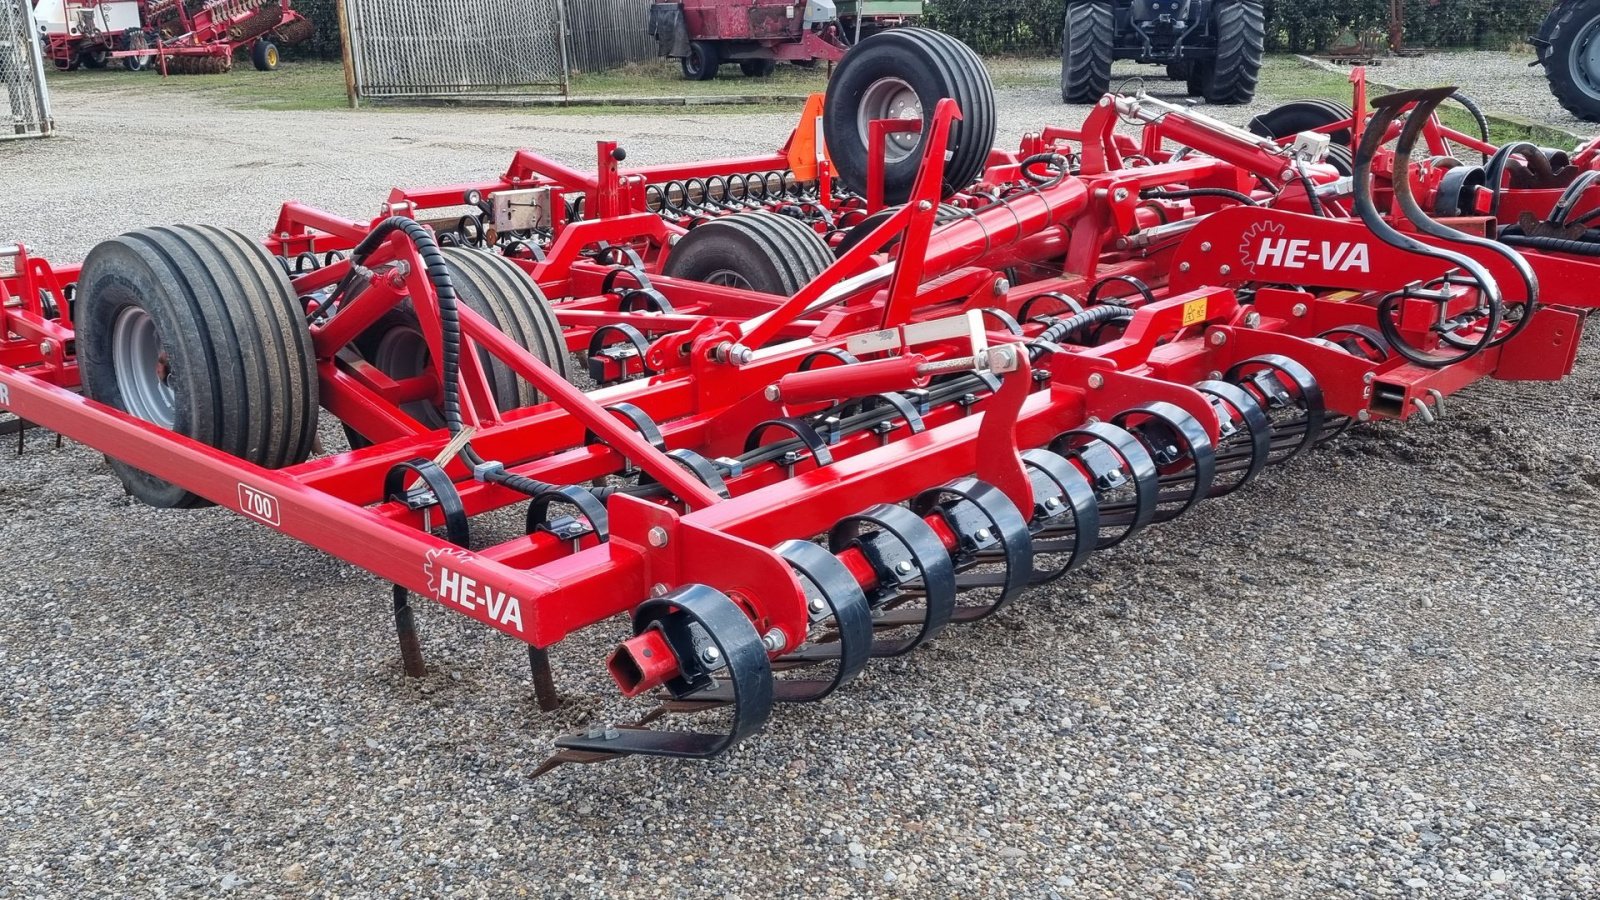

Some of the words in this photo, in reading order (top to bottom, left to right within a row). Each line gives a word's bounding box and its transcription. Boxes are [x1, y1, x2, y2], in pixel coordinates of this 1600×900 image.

[1256, 237, 1370, 273] HE-VA
[245, 489, 272, 519] 700
[440, 567, 524, 633] HE-VA
